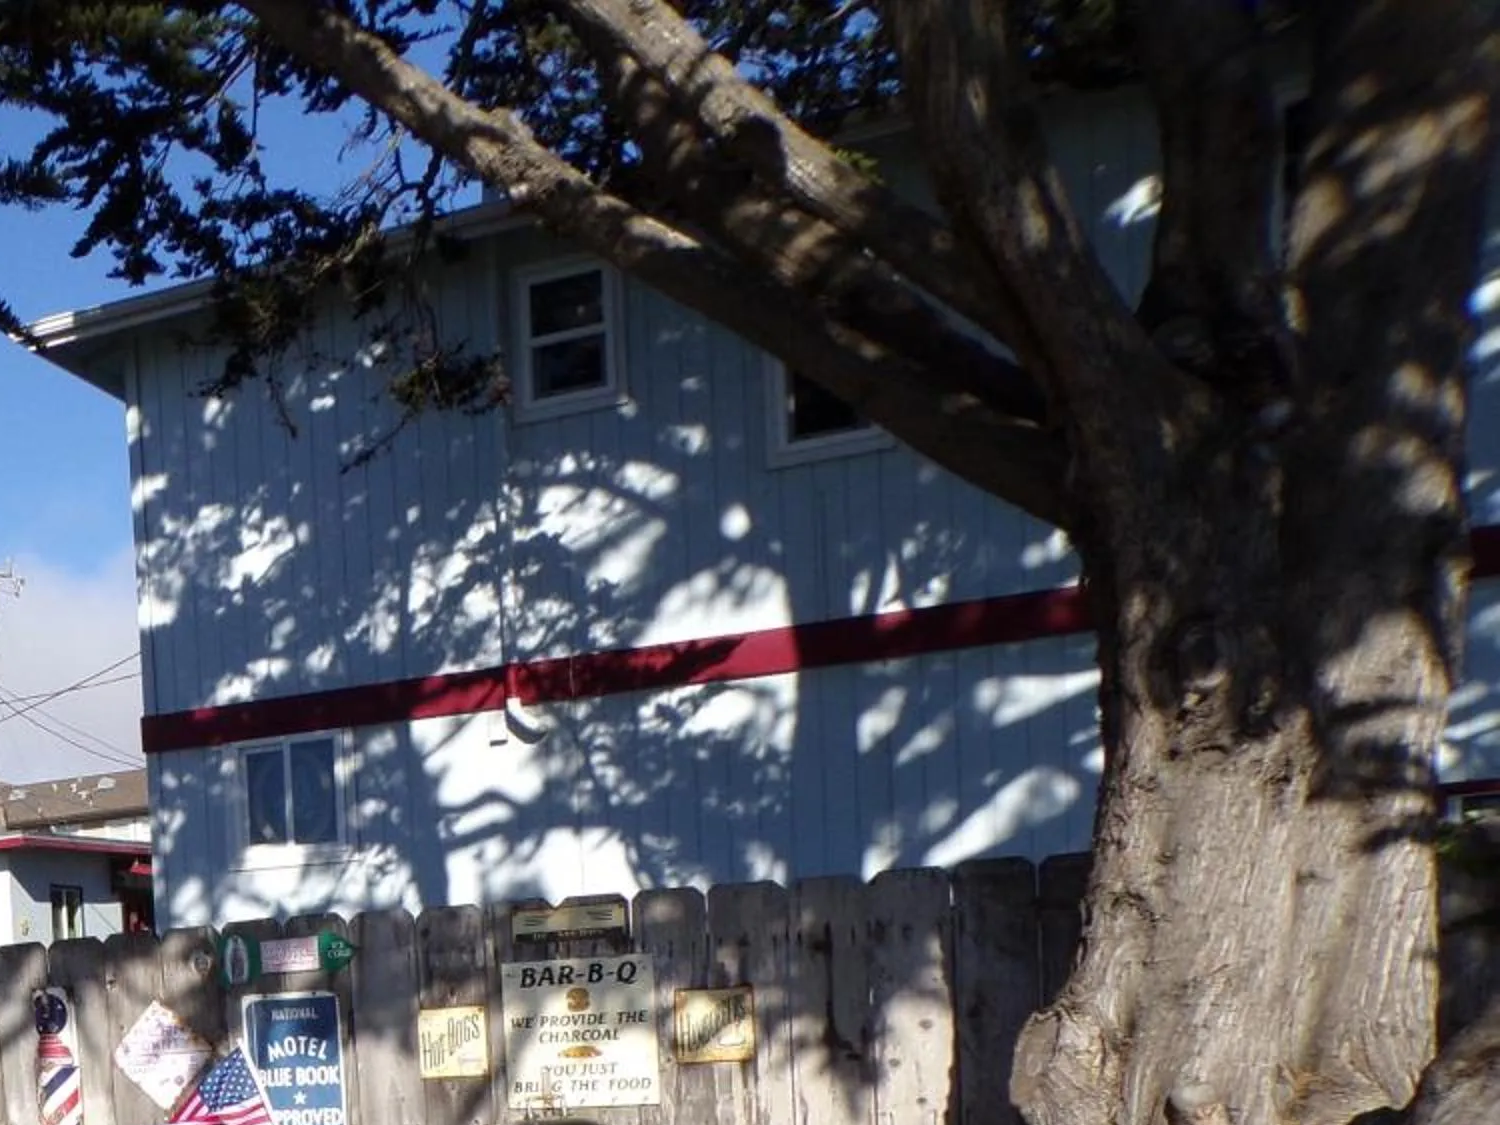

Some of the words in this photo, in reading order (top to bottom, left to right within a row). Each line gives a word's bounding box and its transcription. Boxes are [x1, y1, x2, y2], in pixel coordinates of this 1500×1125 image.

[520, 961, 637, 988] BAR-B-Q
[272, 1008, 319, 1021] NATIONAL
[511, 1017, 534, 1029] WE
[540, 1013, 608, 1028] PROVIDE
[616, 1009, 649, 1024] THE
[539, 1028, 621, 1045] CHARCOAL
[267, 1036, 328, 1063] MOTEL
[296, 1065, 341, 1086] BOOK
[543, 1063, 577, 1078] YOU
[582, 1061, 619, 1077] JUST
[513, 1080, 563, 1094] BRIG
[570, 1079, 599, 1093] THE
[608, 1077, 653, 1092] FOOD
